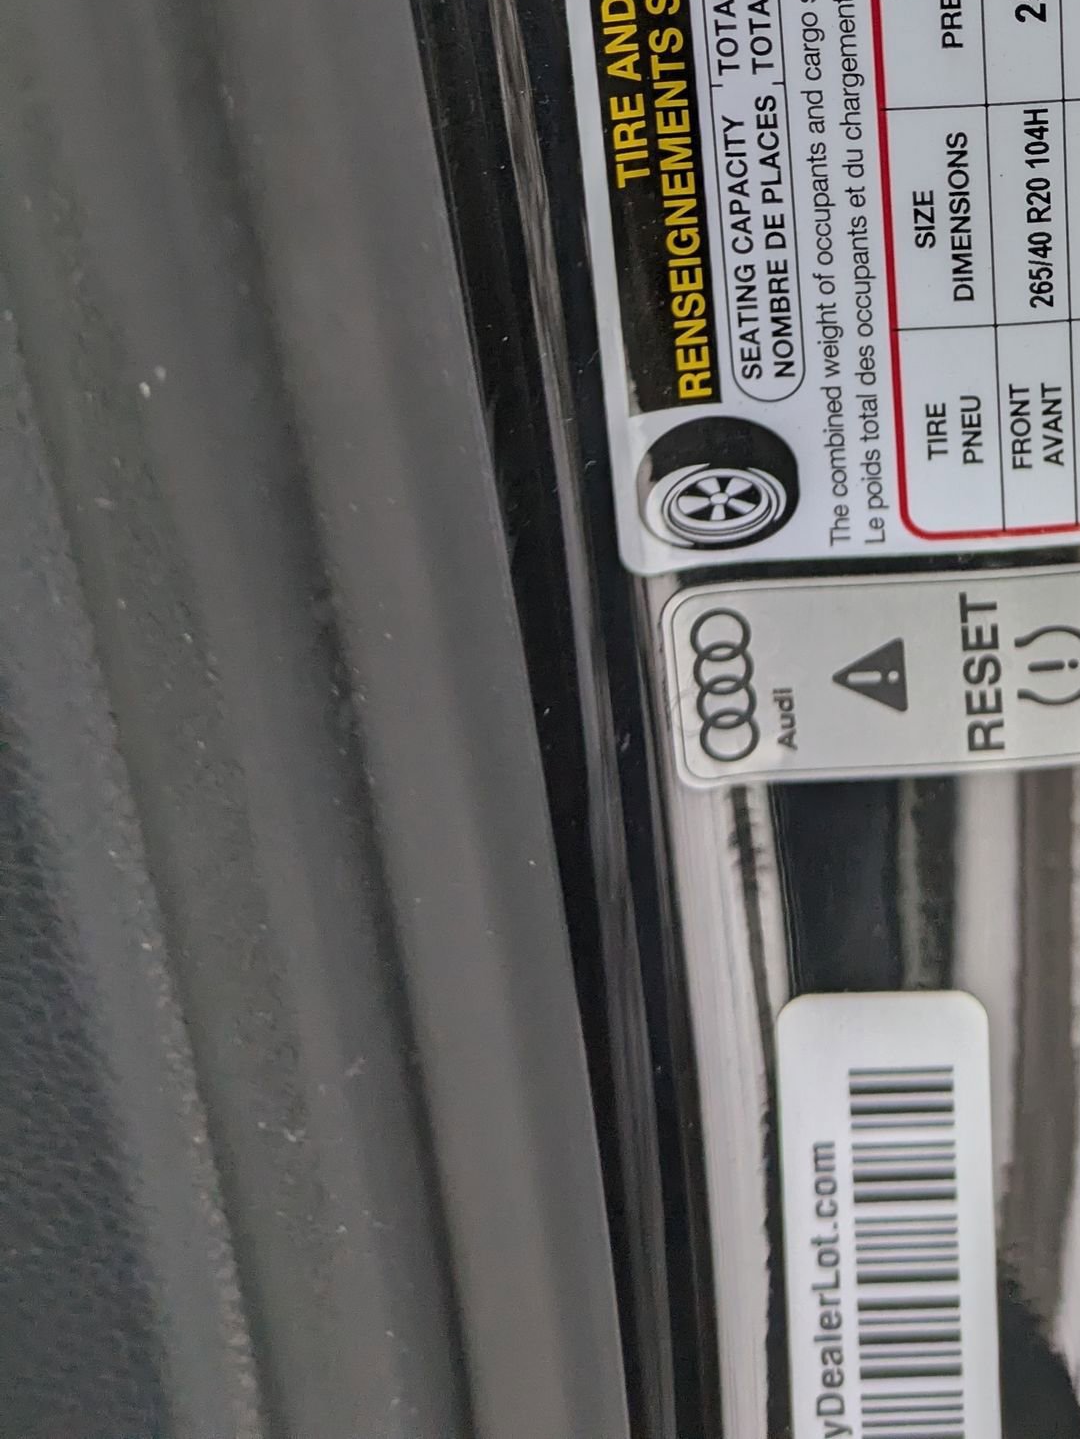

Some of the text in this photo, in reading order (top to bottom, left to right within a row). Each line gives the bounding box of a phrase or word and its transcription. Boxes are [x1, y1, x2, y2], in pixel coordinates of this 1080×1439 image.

[802, 12, 825, 80] cargo
[610, 94, 650, 188] TIRE
[800, 90, 825, 133] and
[842, 149, 864, 178] du
[845, 186, 866, 207] et
[648, 28, 712, 399] RENSEIGNEMENTS
[755, 96, 795, 377] NOMBRE DE PLACES
[806, 142, 836, 265] occupants
[913, 190, 936, 248] SIZE
[946, 132, 974, 301] DIMENSIONS
[1024, 109, 1053, 308] 265/40 R20 104H
[722, 116, 762, 379] SEATING CAPACITY
[847, 216, 876, 337] occupants
[813, 273, 835, 295] of
[816, 303, 843, 378] weight
[855, 345, 876, 385] des
[820, 386, 848, 497] combined
[856, 394, 879, 442] total
[926, 403, 948, 460] TIRE
[960, 396, 983, 464] PNEU
[1009, 384, 1032, 469] FRONT
[1041, 383, 1064, 466] AVANT
[860, 449, 889, 509] poids
[830, 504, 850, 546] The
[865, 517, 885, 544] Le
[959, 592, 1004, 751] RESET
[773, 688, 797, 750] Audi
